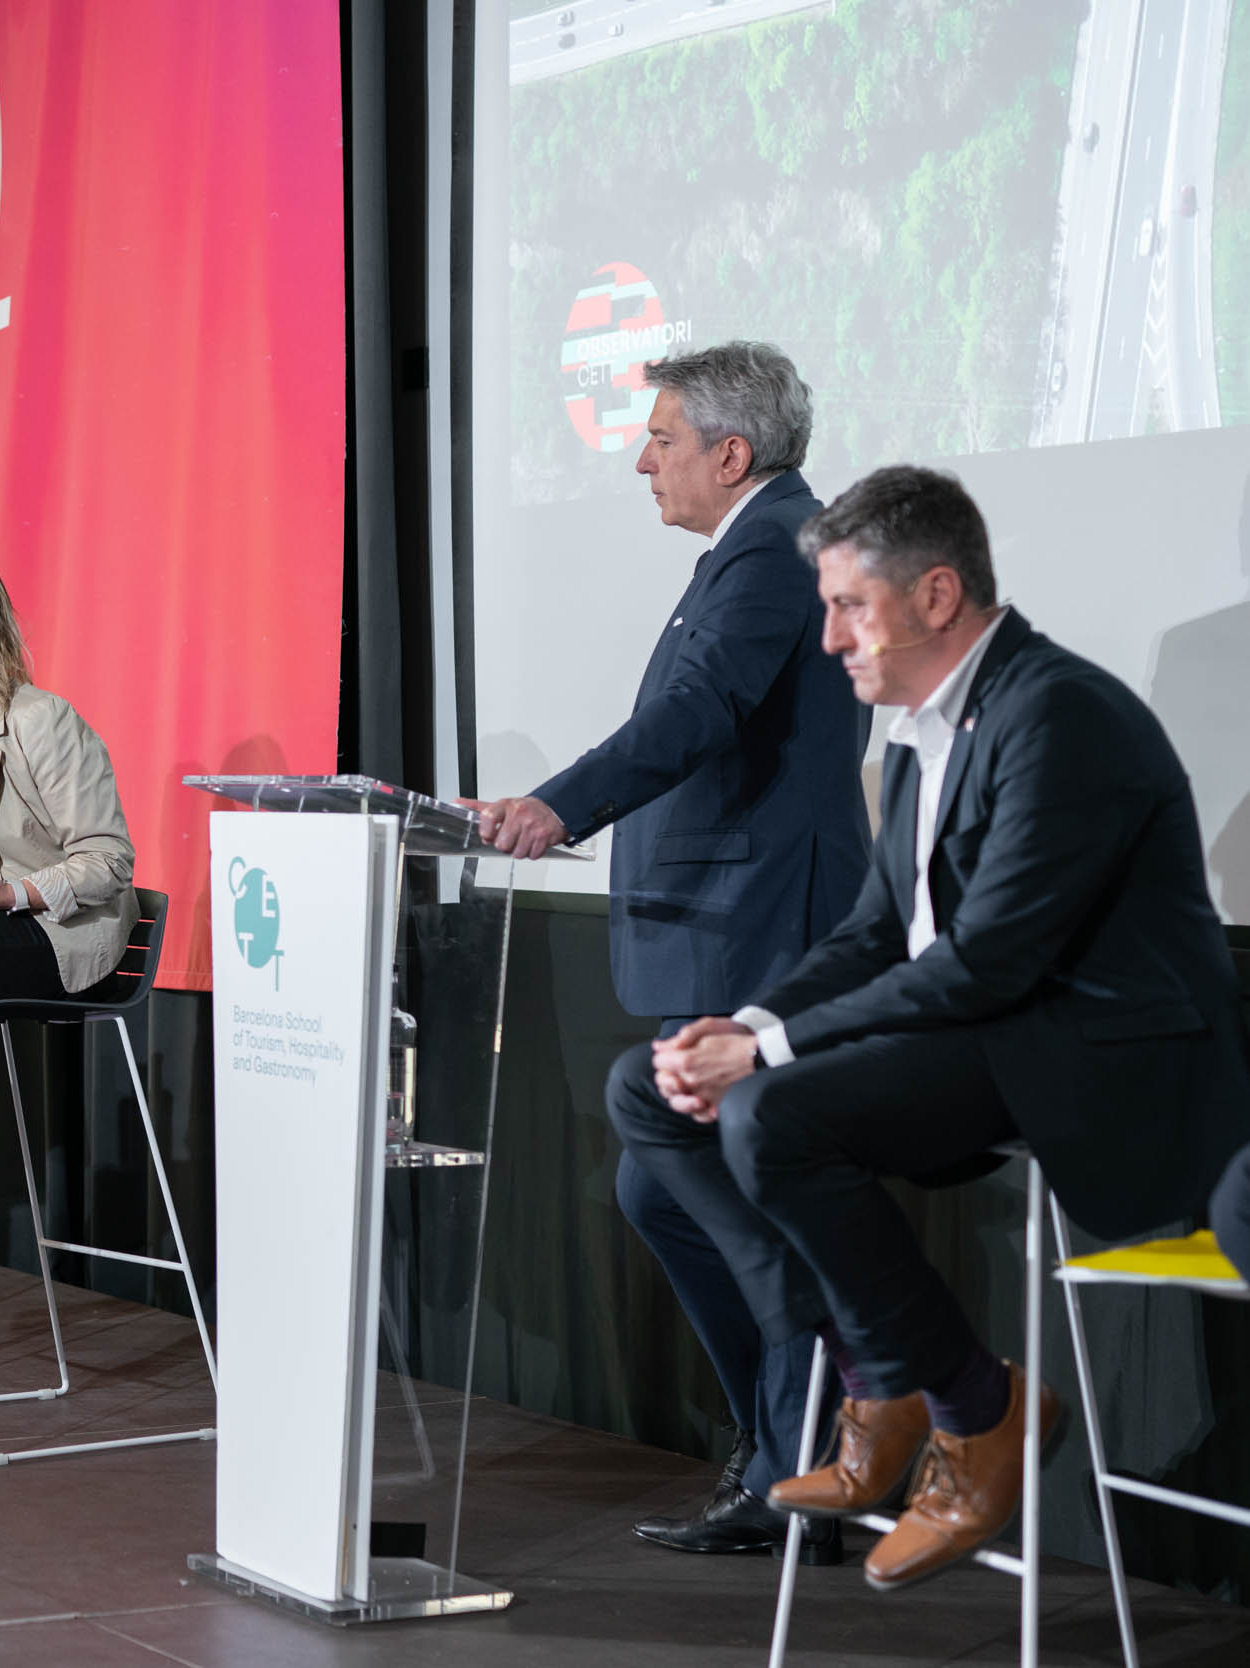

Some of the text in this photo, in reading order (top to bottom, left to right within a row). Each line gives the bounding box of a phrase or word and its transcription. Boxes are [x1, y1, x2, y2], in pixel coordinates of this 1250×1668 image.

[577, 319, 692, 361] OBSERVATORI
[577, 359, 615, 388] CETT
[233, 1004, 323, 1033] Barcelona School
[233, 1028, 345, 1067] of Tourism, Hospitality
[232, 1053, 317, 1088] and Gastronomy
